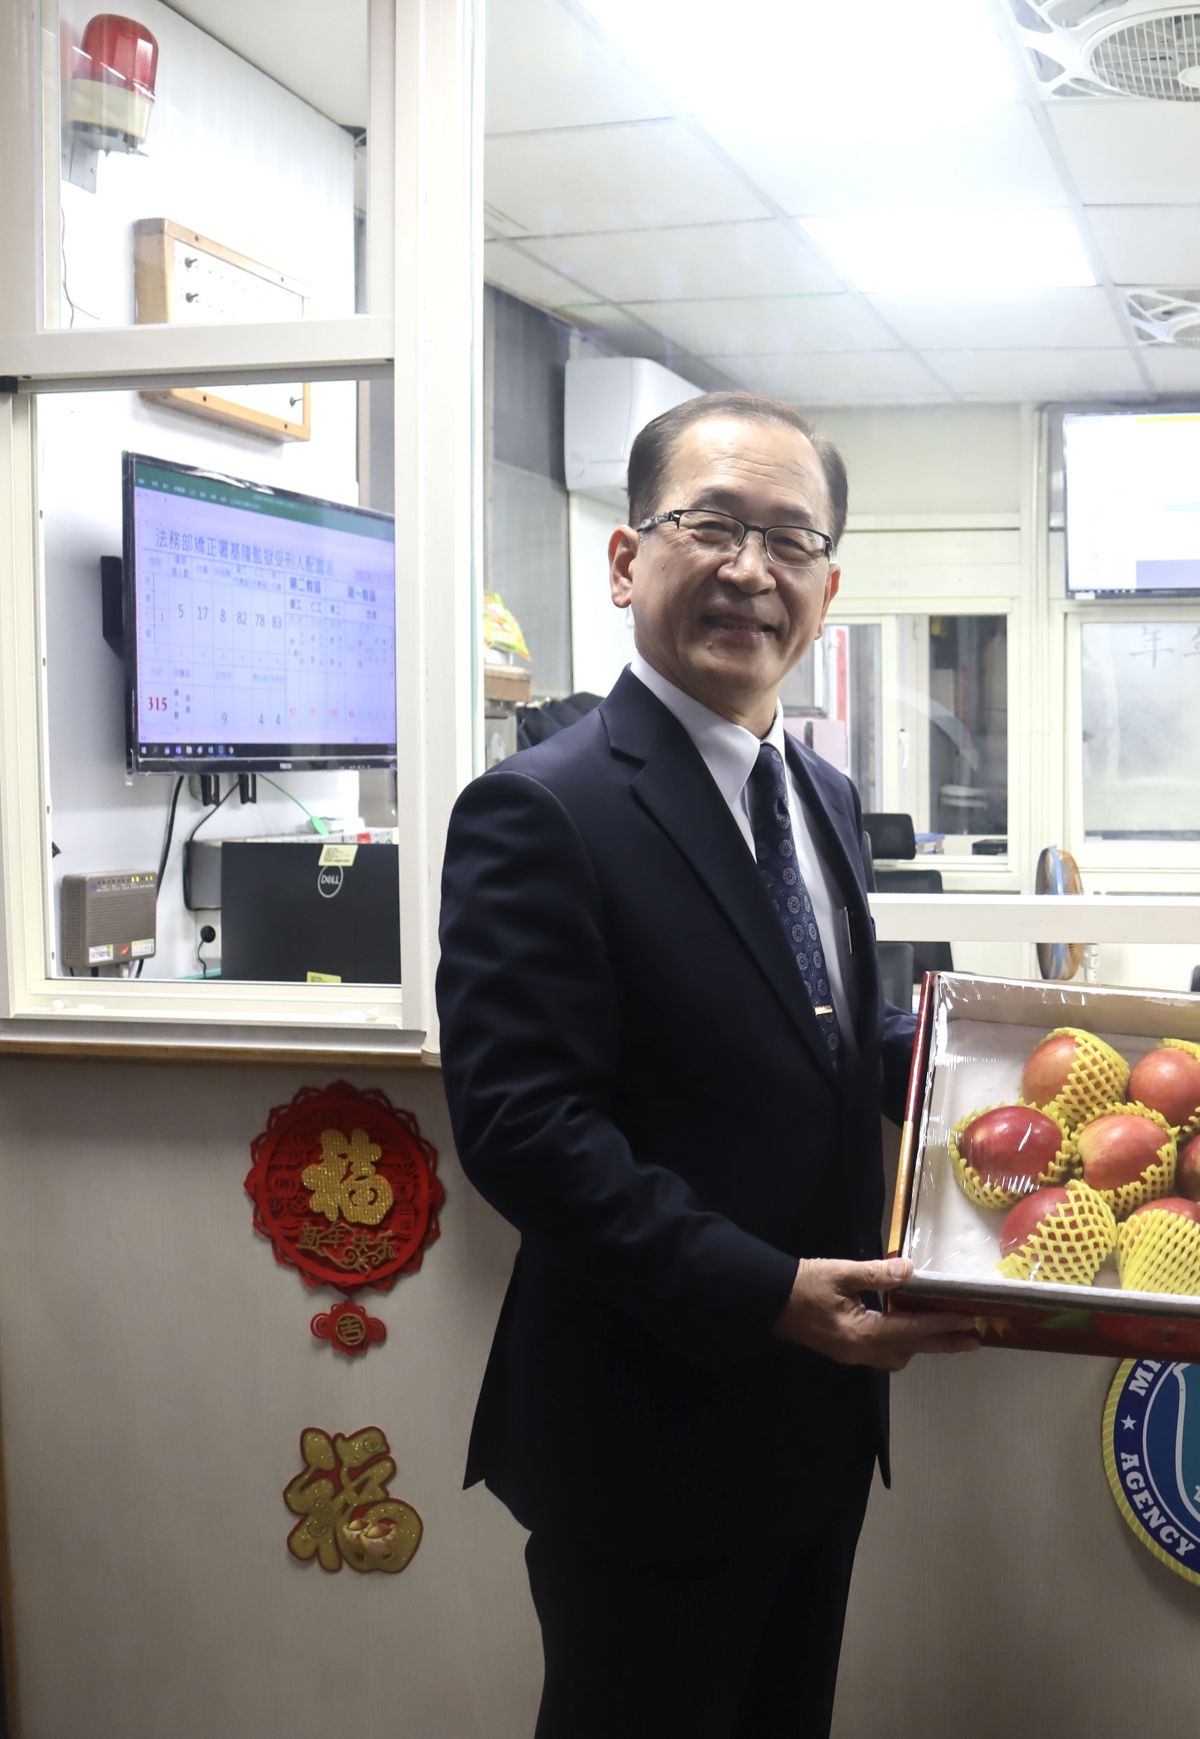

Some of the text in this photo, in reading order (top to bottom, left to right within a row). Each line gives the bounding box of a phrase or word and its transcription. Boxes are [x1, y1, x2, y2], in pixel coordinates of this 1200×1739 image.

[178, 603, 185, 619] 5
[197, 605, 209, 621] 17
[219, 608, 226, 624] 8
[236, 610, 248, 626] 82
[254, 612, 266, 628] 78
[320, 873, 340, 885] DELL
[302, 1128, 394, 1225] 福
[1120, 1452, 1196, 1557] AGENCY
